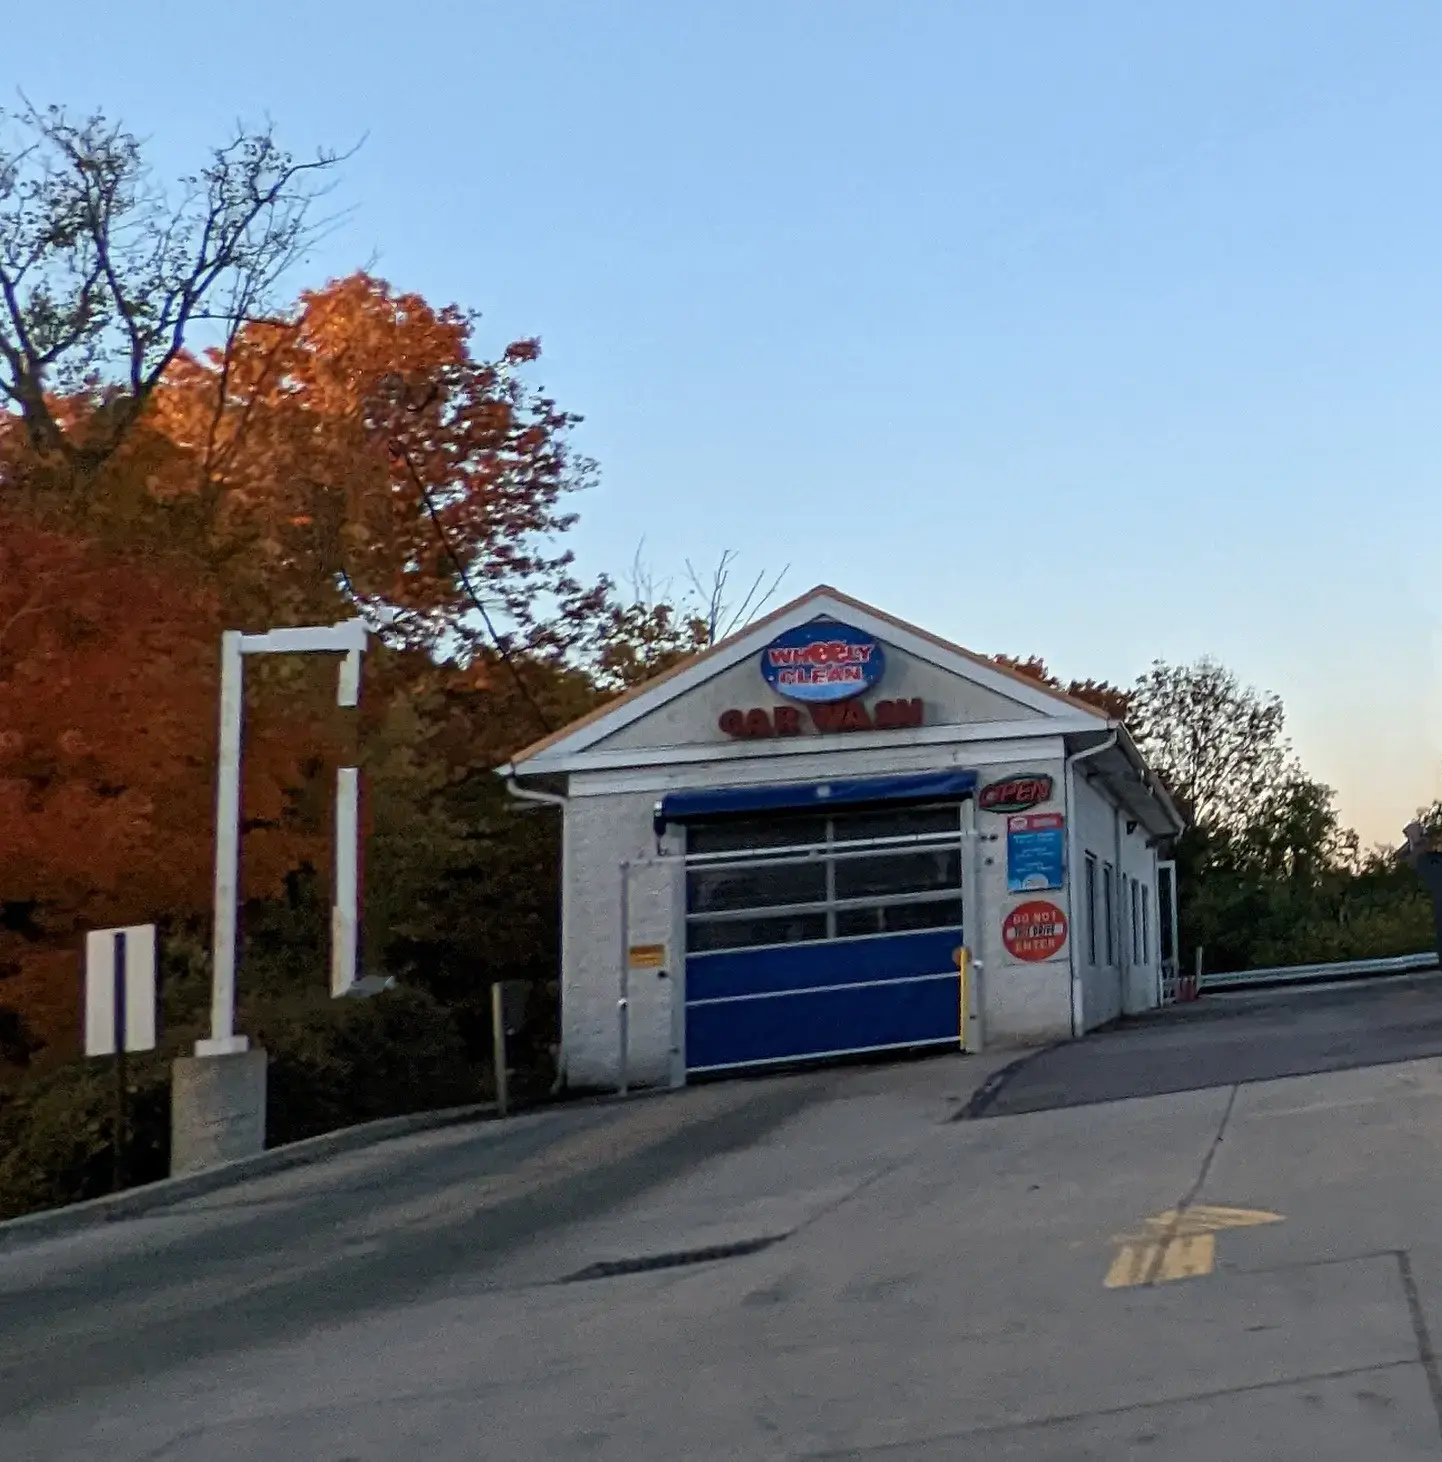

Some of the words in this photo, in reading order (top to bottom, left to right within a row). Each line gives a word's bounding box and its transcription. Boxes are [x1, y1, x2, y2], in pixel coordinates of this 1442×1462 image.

[778, 665, 864, 685] CLEAN
[718, 705, 800, 739] CAR
[806, 698, 924, 732] WASH
[979, 779, 1050, 807] OPEN
